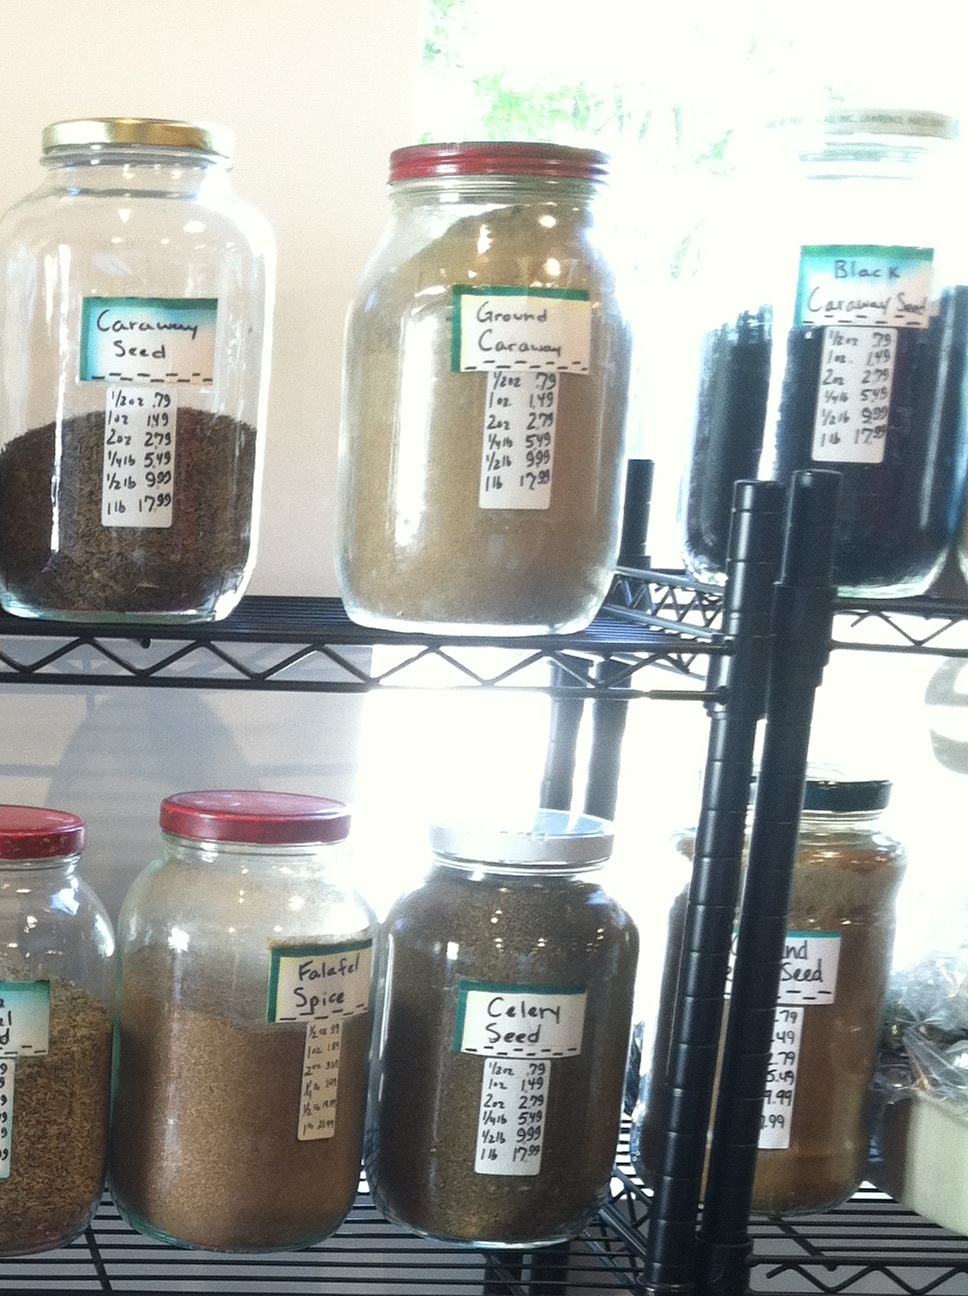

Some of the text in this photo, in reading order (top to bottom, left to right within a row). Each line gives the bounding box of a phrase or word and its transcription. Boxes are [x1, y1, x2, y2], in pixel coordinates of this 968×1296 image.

[835, 259, 901, 279] Black
[476, 301, 547, 323] Ground
[808, 287, 927, 314] Caraway Seed
[96, 309, 197, 339] Caraway
[113, 340, 166, 358] Seed
[478, 328, 561, 357] Caraway
[299, 953, 360, 981] Falafel
[782, 958, 823, 982] Seed
[294, 987, 345, 1013] Spice
[488, 997, 560, 1023] Celery
[486, 1023, 541, 1043] Seed
